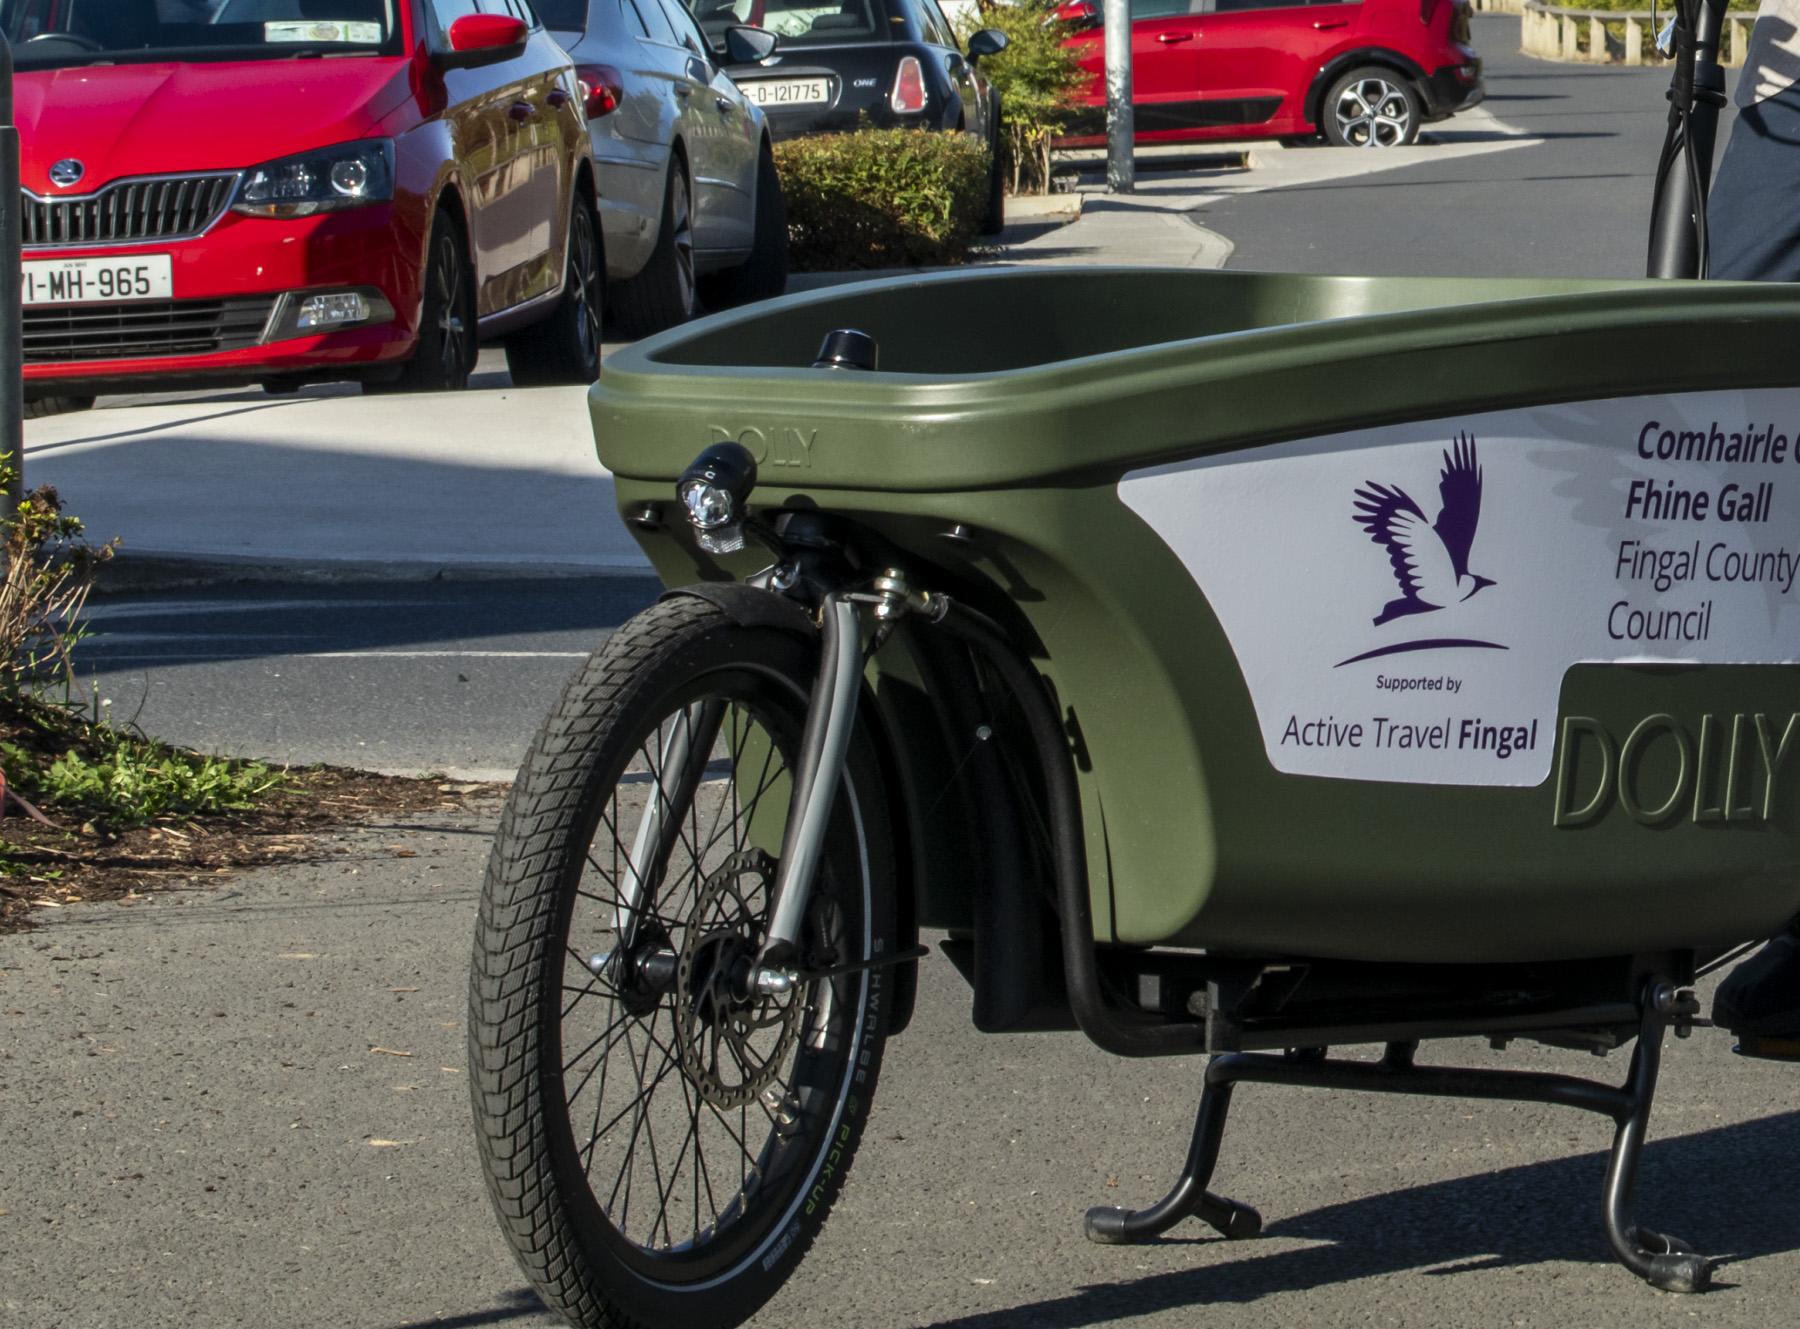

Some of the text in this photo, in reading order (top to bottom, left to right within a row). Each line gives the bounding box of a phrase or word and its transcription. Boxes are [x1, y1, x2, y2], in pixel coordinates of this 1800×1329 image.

[853, 78, 877, 87] ONE
[22, 266, 150, 301] 1-MH-965
[1637, 421, 1788, 464] Comhairle
[1625, 479, 1773, 522] Fhine Gall
[1615, 540, 1800, 594] Fingal County
[1607, 600, 1712, 640] Council
[1376, 675, 1462, 693] Supported by
[1281, 715, 1538, 759] Active Travel Fingal
